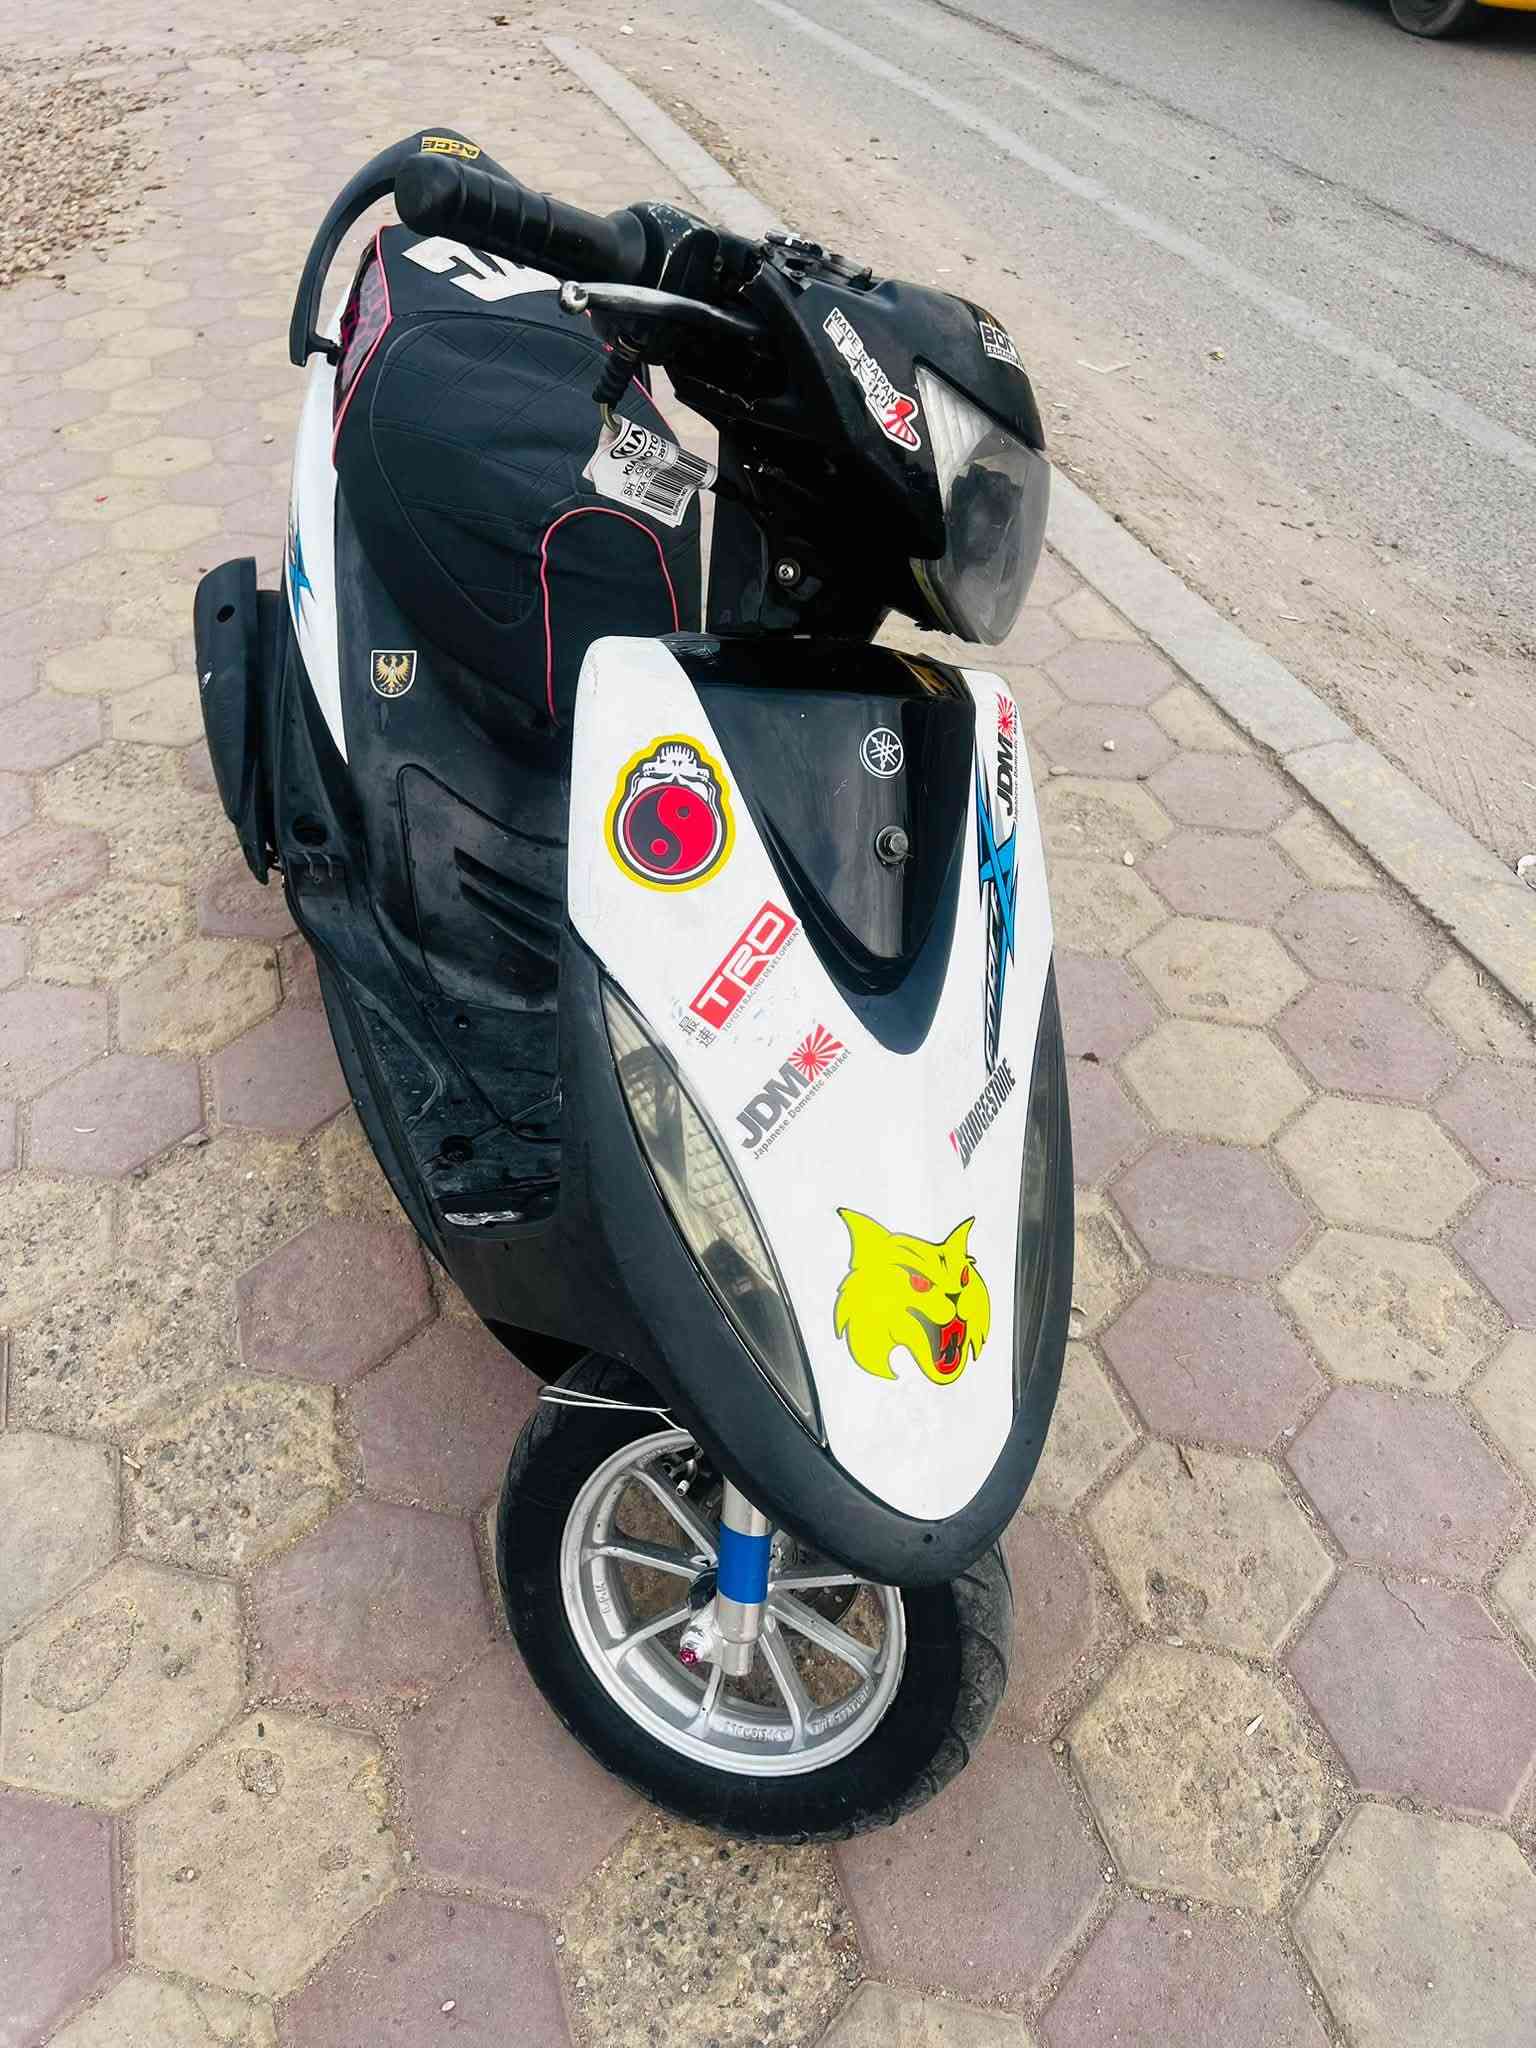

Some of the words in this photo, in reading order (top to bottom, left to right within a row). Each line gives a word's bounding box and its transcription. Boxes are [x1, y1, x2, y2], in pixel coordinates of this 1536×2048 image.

[832, 309, 861, 348] MADE
[865, 360, 899, 405] JAPAN
[614, 430, 644, 456] KIA
[996, 730, 1014, 817] JDM
[696, 910, 786, 1010] TRD
[735, 1061, 812, 1150] JDM
[752, 1118, 791, 1161] Japanese
[786, 1078, 825, 1120] Domestic
[822, 1047, 852, 1080] Market
[948, 1056, 1017, 1170] BRIDGESTONE
